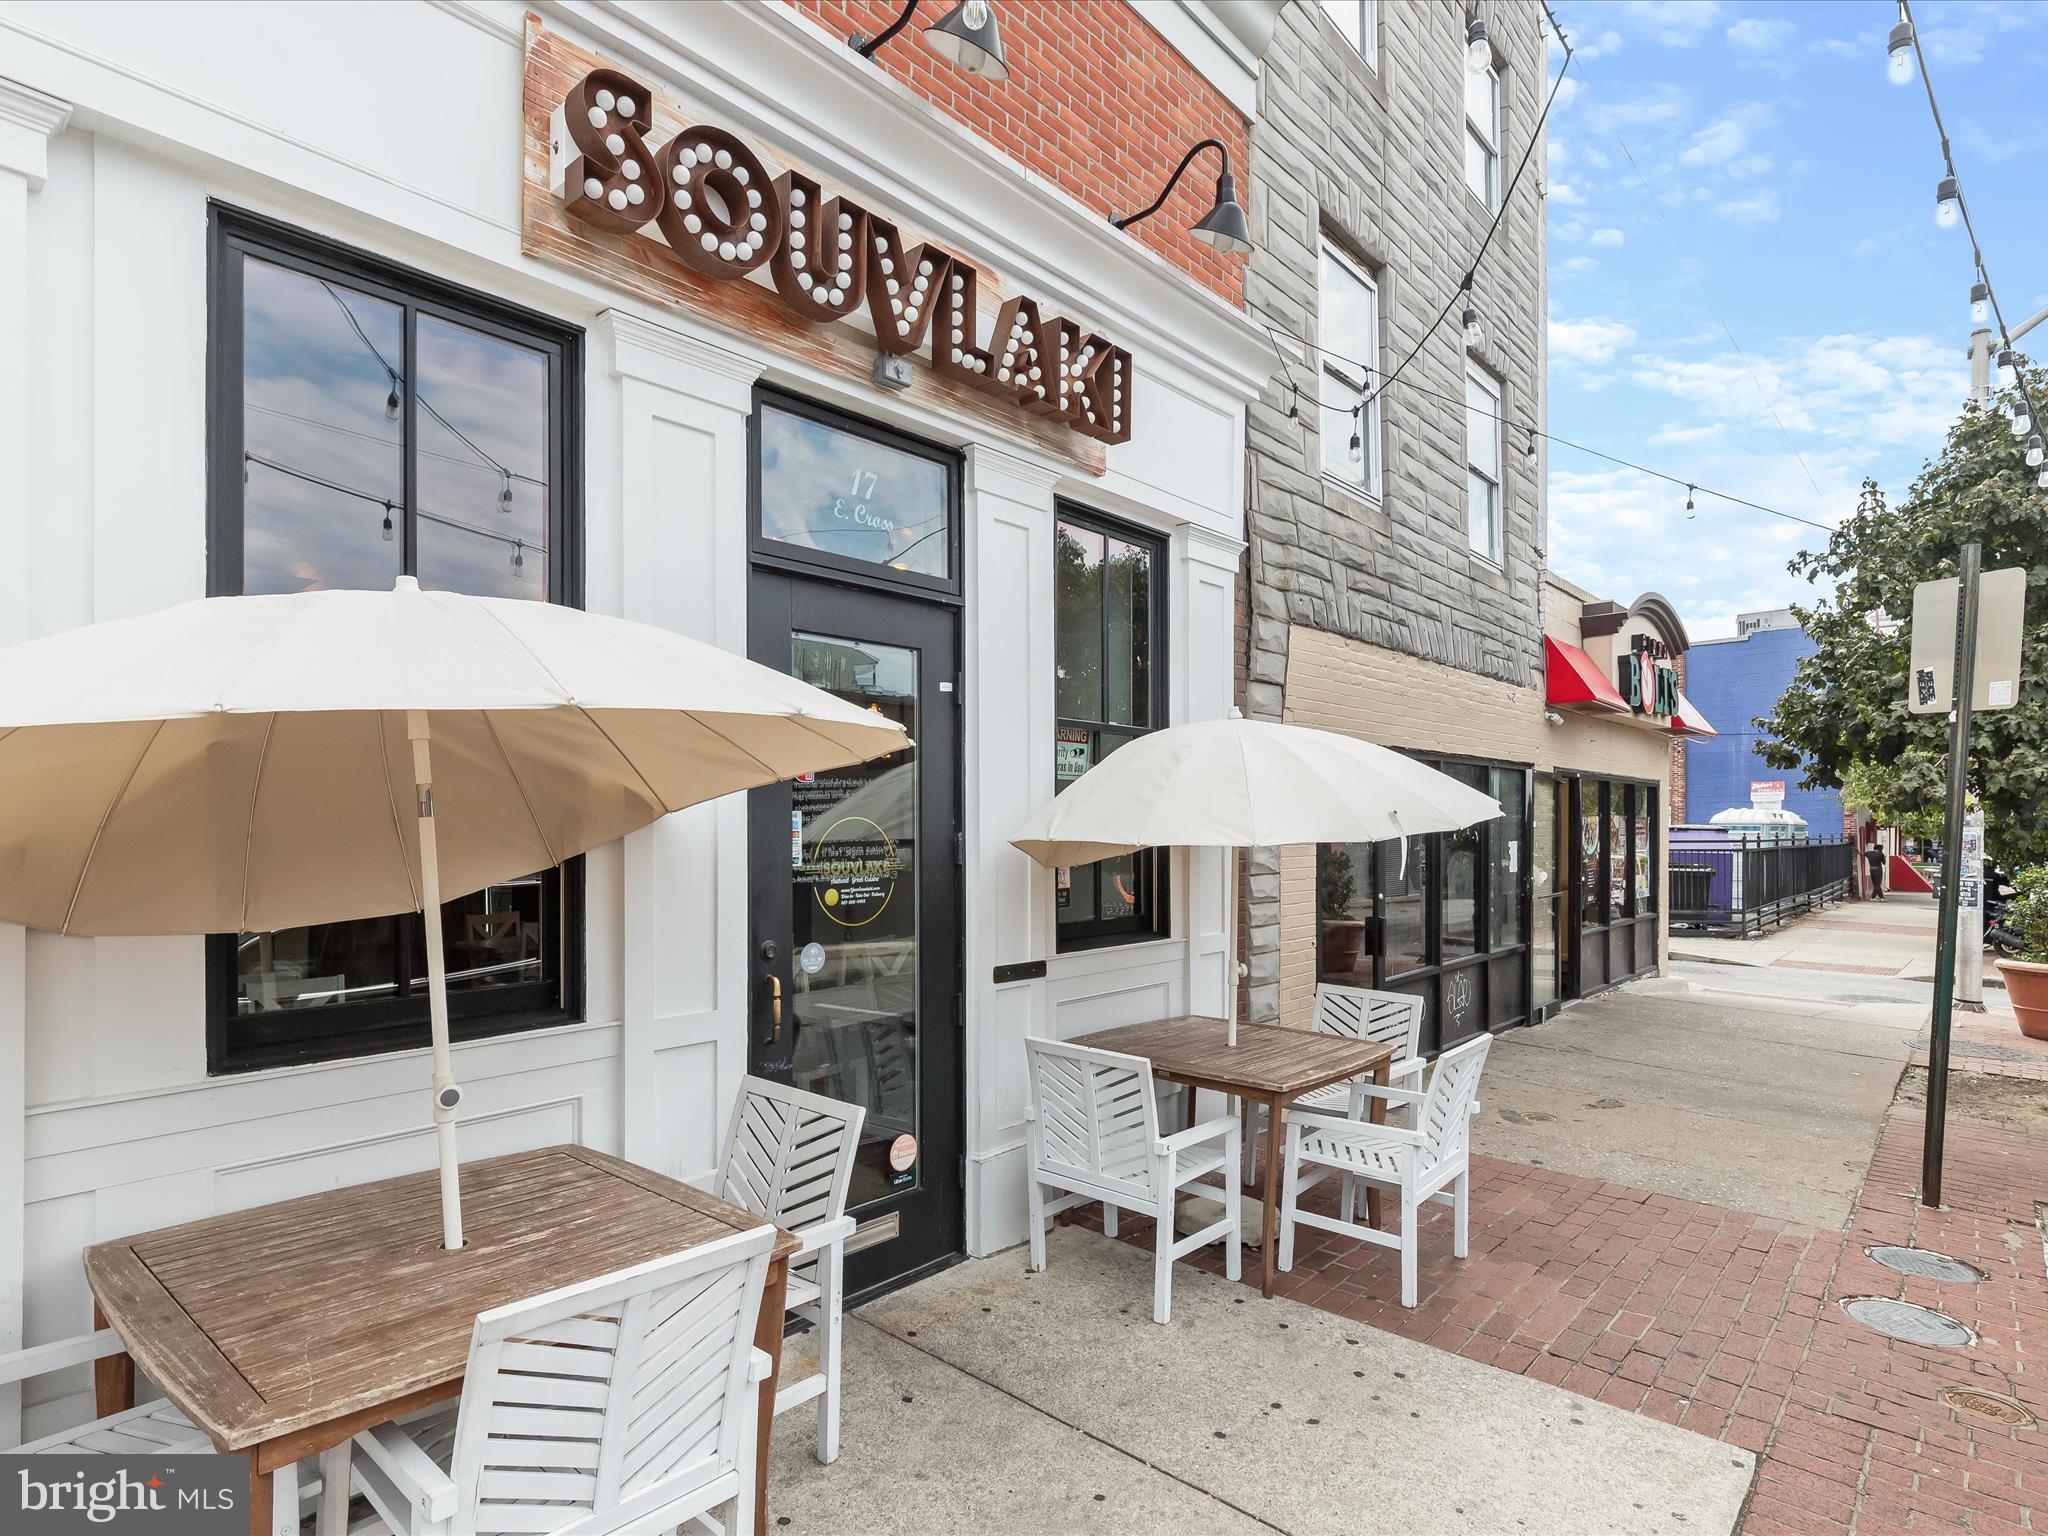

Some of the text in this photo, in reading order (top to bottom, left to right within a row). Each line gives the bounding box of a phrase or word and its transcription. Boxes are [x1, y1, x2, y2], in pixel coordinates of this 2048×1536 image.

[564, 68, 1132, 446] SOUVLAKI
[851, 469, 878, 500] 17
[833, 498, 894, 532] E. Cross
[1056, 728, 1087, 743] ARNING
[1057, 746, 1069, 760] rity
[1074, 762, 1084, 773] Use
